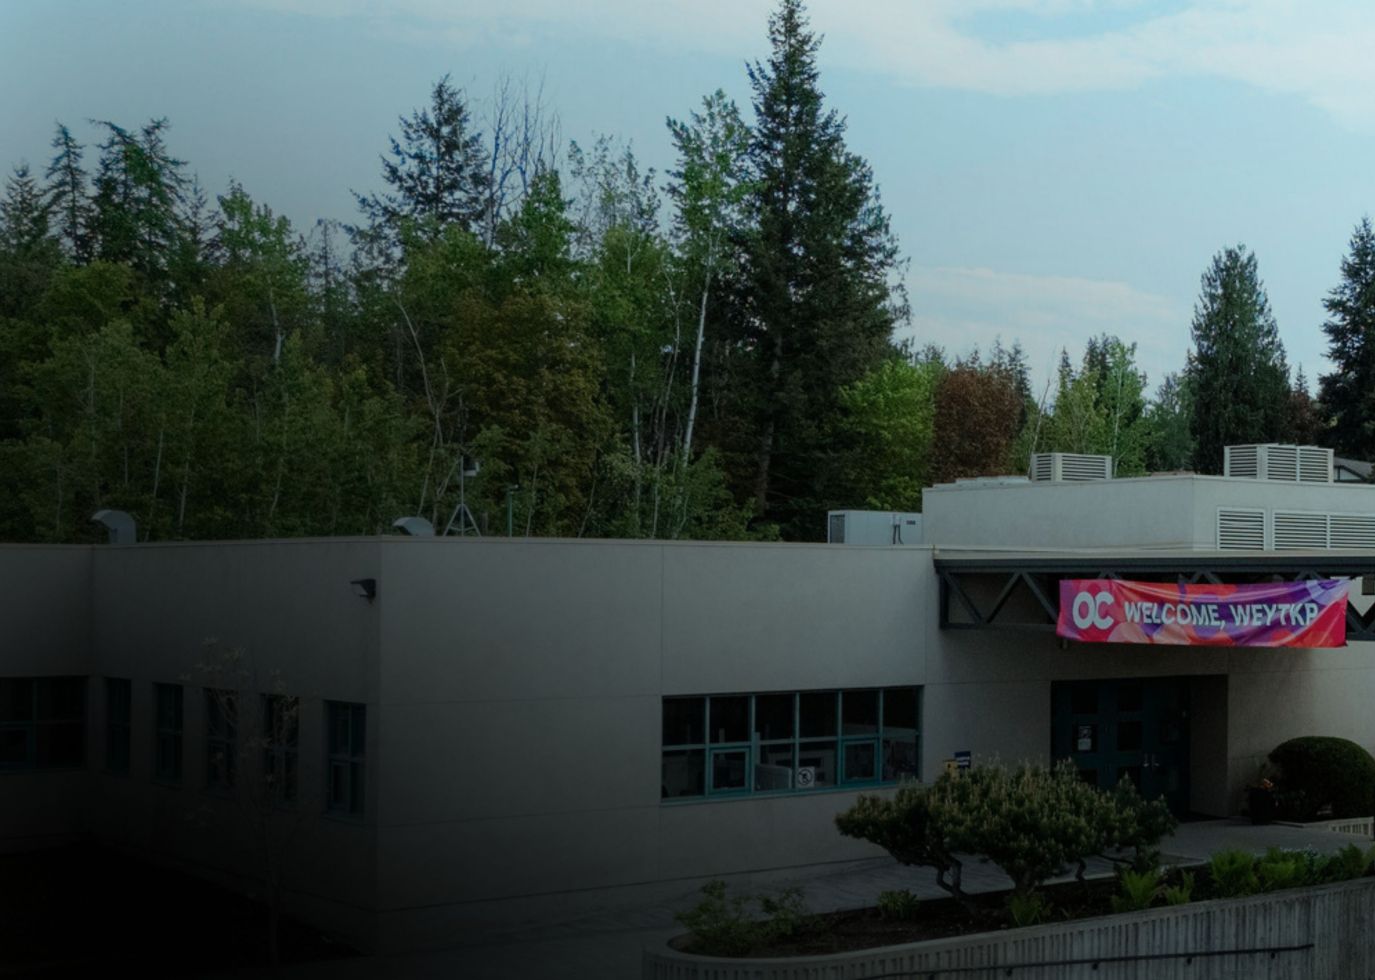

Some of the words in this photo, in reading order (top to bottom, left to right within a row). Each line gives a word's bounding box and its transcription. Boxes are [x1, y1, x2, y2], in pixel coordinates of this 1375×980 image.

[1072, 591, 1115, 630] OC
[1124, 602, 1227, 630] WELCOME,
[1229, 603, 1319, 627] WEYTKP
